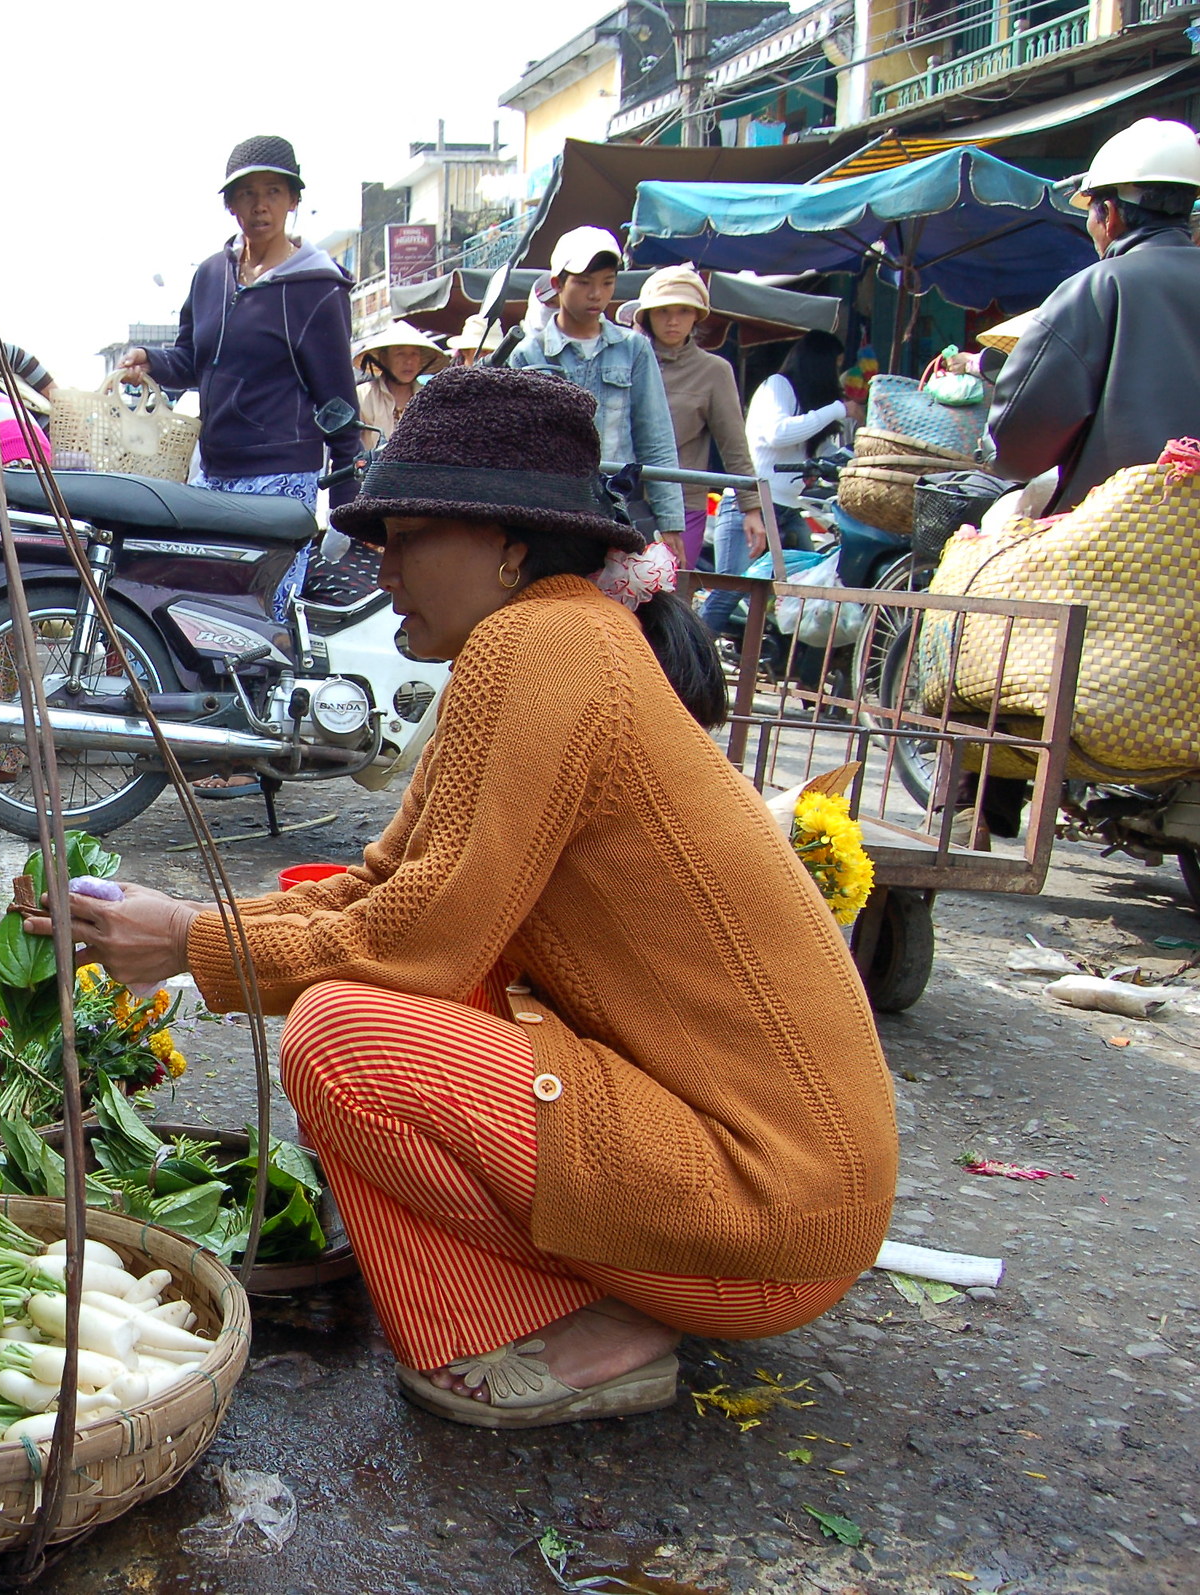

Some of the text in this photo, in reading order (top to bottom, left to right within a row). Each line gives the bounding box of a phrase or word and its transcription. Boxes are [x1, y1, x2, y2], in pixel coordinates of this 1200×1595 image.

[160, 543, 207, 555] SANDA
[195, 631, 265, 649] BOSS
[319, 702, 362, 711] SANDA
